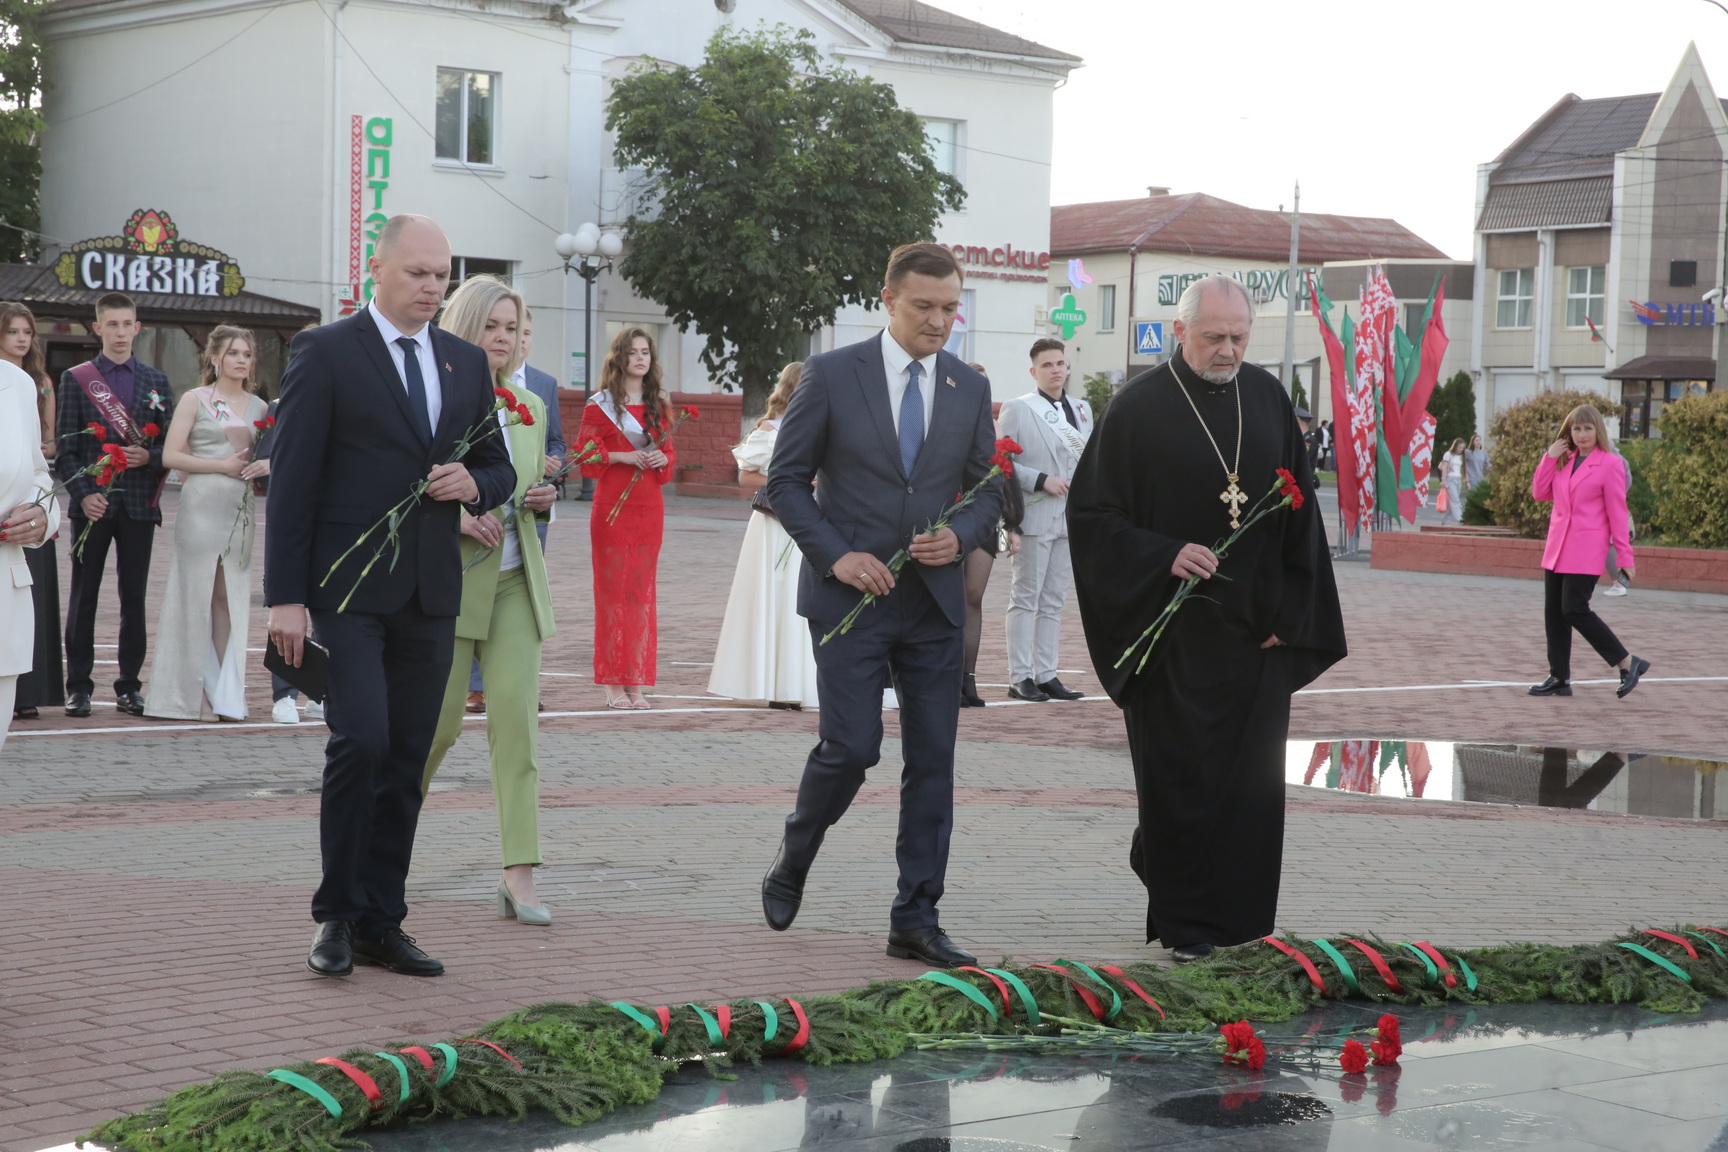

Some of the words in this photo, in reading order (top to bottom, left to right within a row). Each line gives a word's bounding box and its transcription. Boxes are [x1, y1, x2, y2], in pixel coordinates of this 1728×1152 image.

[941, 243, 1050, 270] стские
[81, 250, 220, 296] СКАЗКА
[1055, 312, 1083, 322] АПТЕКА
